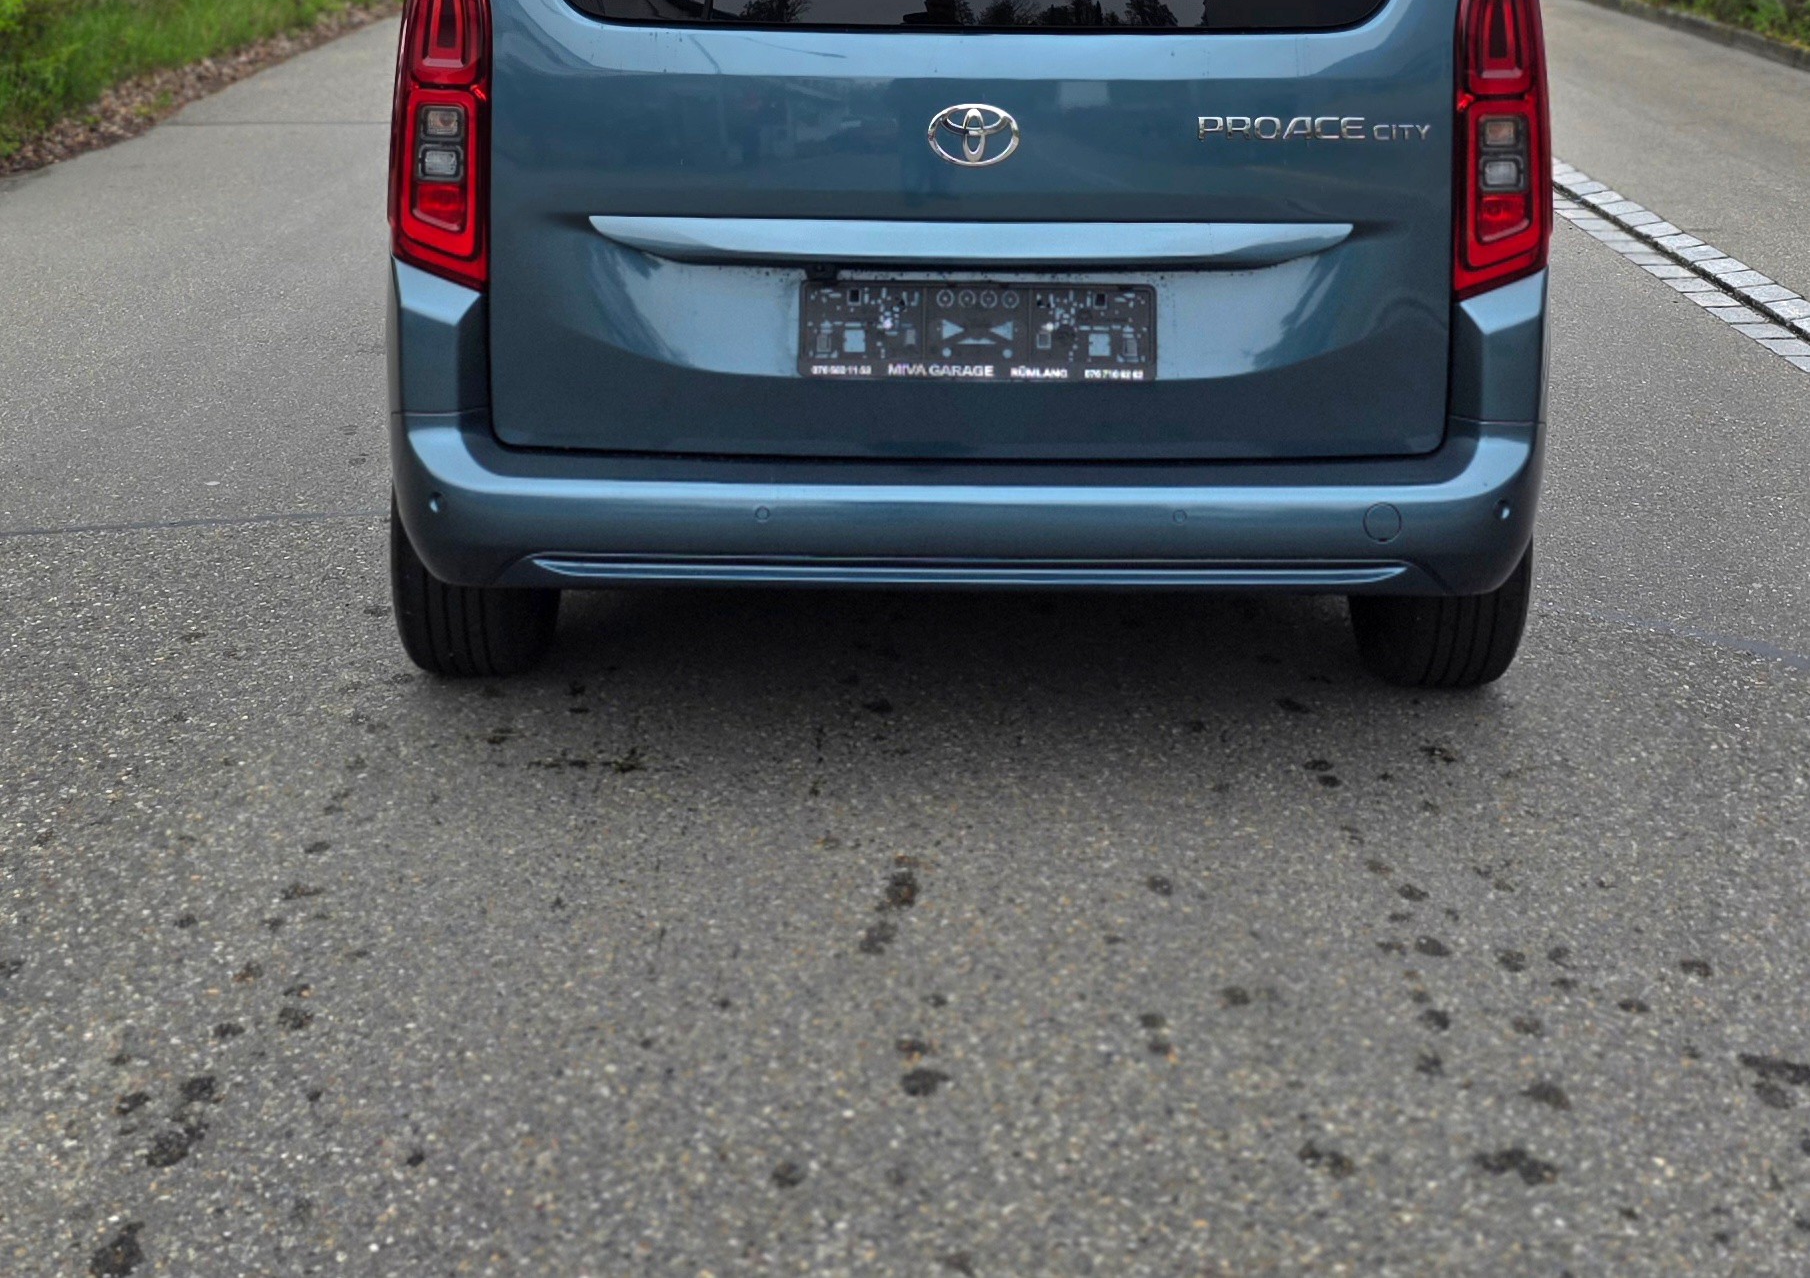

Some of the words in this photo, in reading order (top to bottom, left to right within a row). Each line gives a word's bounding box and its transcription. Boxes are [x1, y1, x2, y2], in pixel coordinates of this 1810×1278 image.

[1197, 116, 1366, 141] PROACE
[1372, 124, 1431, 141] CITY
[888, 364, 926, 376] MIVA
[929, 364, 994, 377] GARAGE
